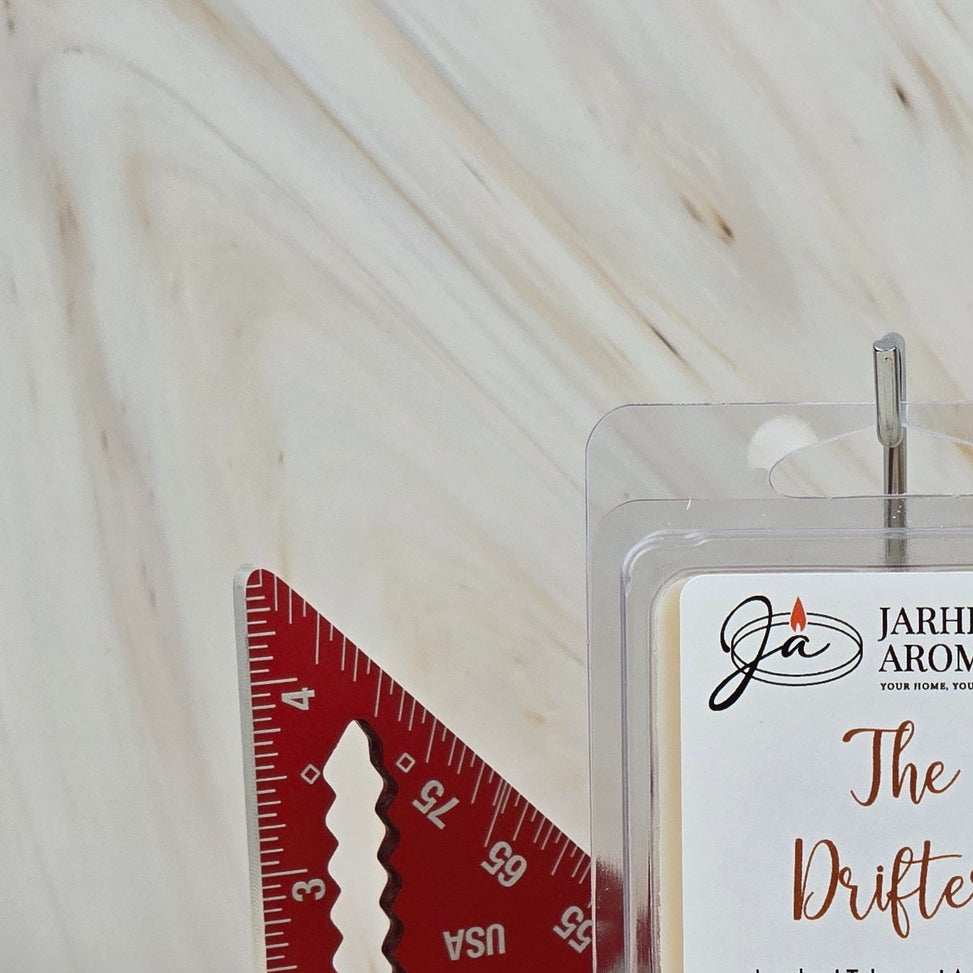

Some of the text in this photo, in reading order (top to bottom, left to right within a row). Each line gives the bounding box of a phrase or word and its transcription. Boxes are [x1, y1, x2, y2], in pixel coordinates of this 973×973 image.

[281, 687, 315, 710] 4
[879, 682, 911, 691] YOUR
[913, 682, 949, 691] HOME,
[843, 720, 960, 806] The
[412, 780, 459, 829] 75
[481, 841, 527, 887] 65
[292, 879, 325, 901] 3
[443, 924, 505, 960] USA
